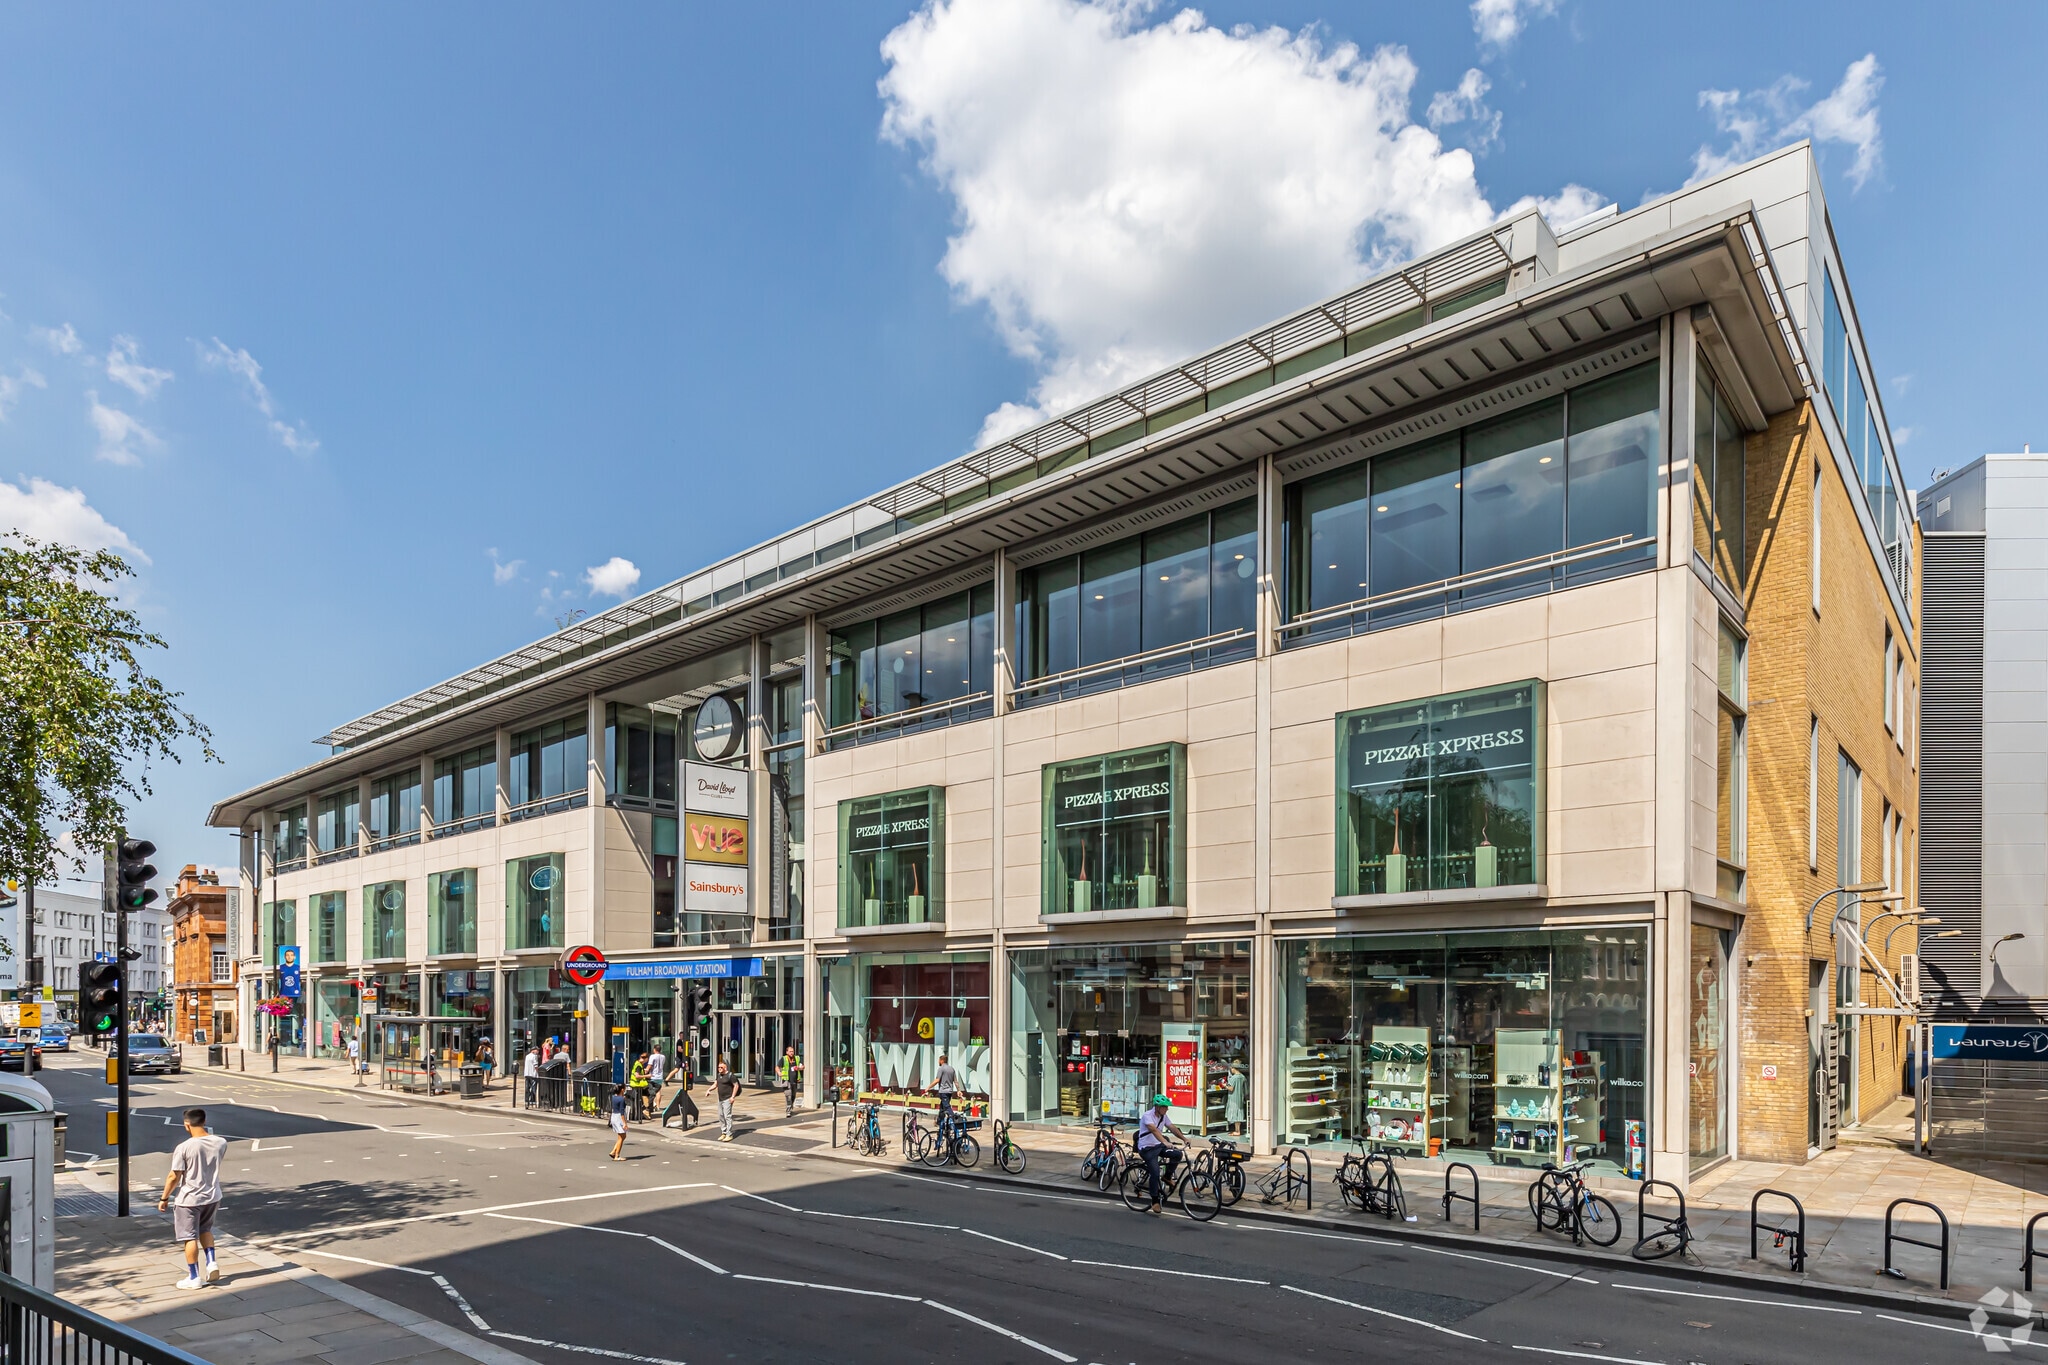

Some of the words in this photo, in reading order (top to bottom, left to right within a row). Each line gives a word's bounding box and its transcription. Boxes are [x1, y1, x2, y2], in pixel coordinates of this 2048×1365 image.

[697, 779, 719, 791] David
[719, 782, 736, 795] Lloyd
[689, 881, 744, 896] Sainsbury's
[626, 966, 653, 976] FULHAM
[654, 965, 693, 976] BROADWAY
[695, 963, 726, 974] STATION
[1949, 1038, 2031, 1048] Laureus
[1169, 1065, 1193, 1076] SUMMER
[1454, 1071, 1489, 1080] wilko.com
